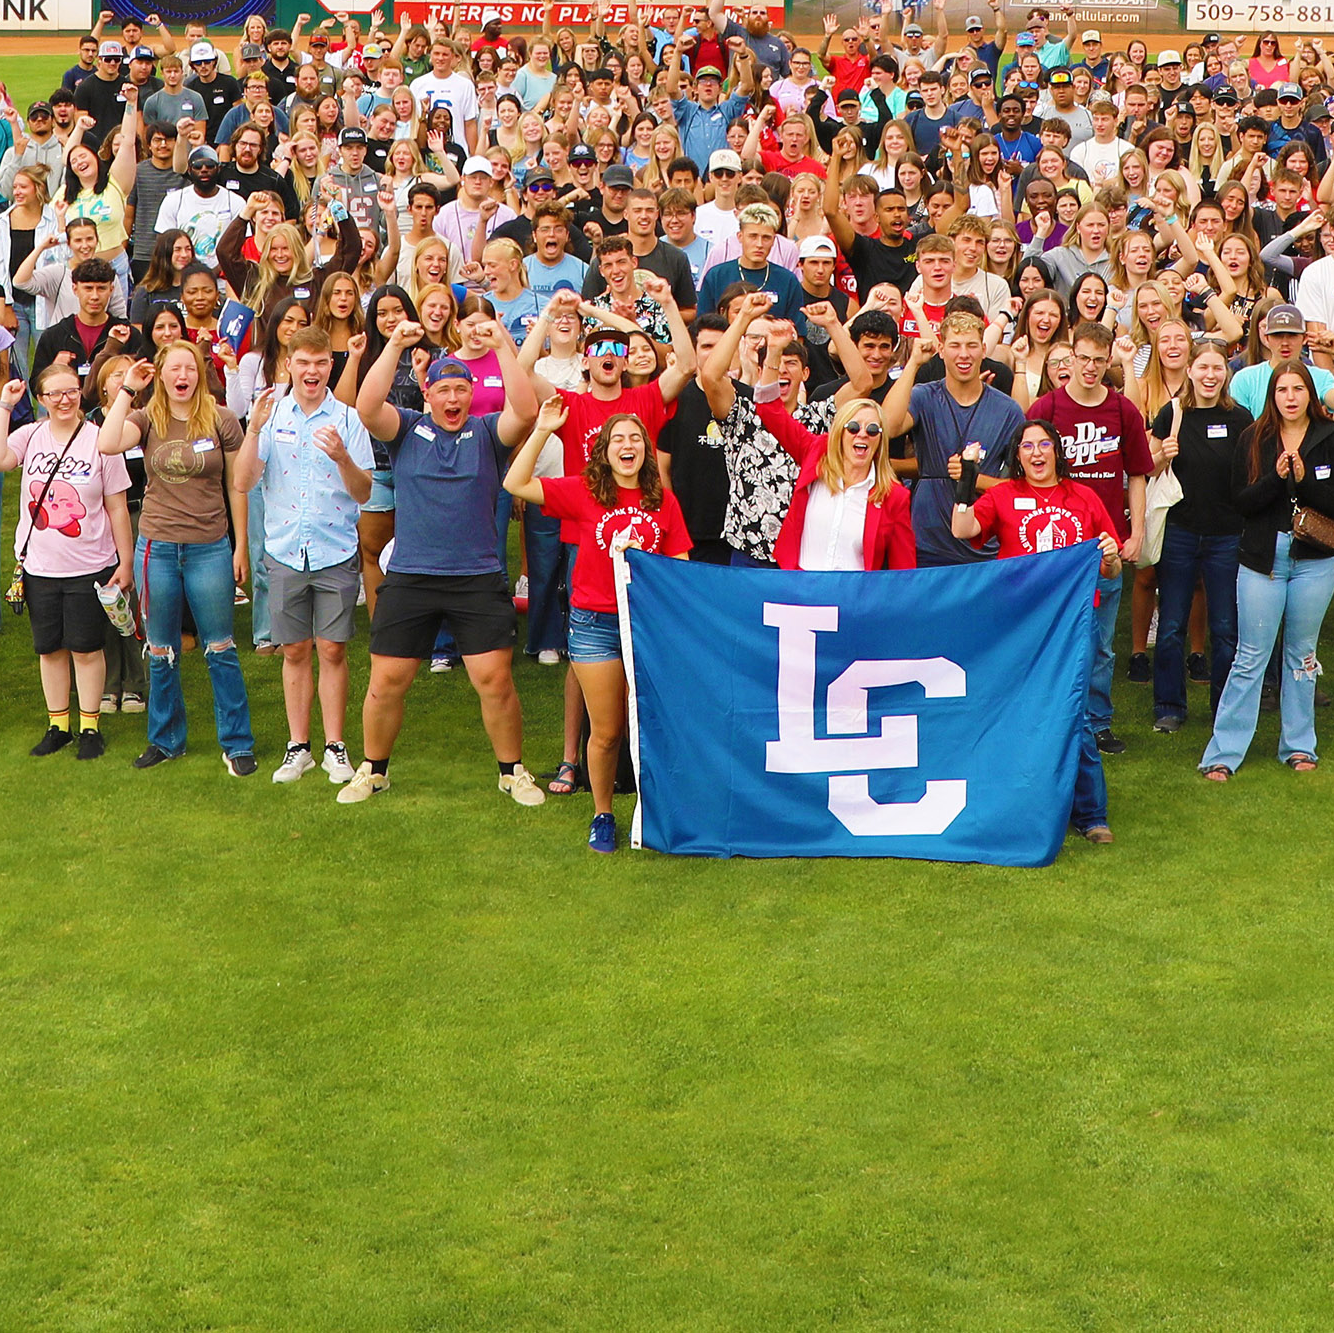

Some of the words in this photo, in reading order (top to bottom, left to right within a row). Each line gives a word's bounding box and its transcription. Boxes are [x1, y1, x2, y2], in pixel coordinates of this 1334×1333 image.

[1074, 422, 1107, 444] Dr
[628, 506, 653, 521] STATE
[1018, 509, 1045, 553] LEWIS-CLARK
[1046, 506, 1071, 518] STATE
[763, 601, 967, 837] LC
